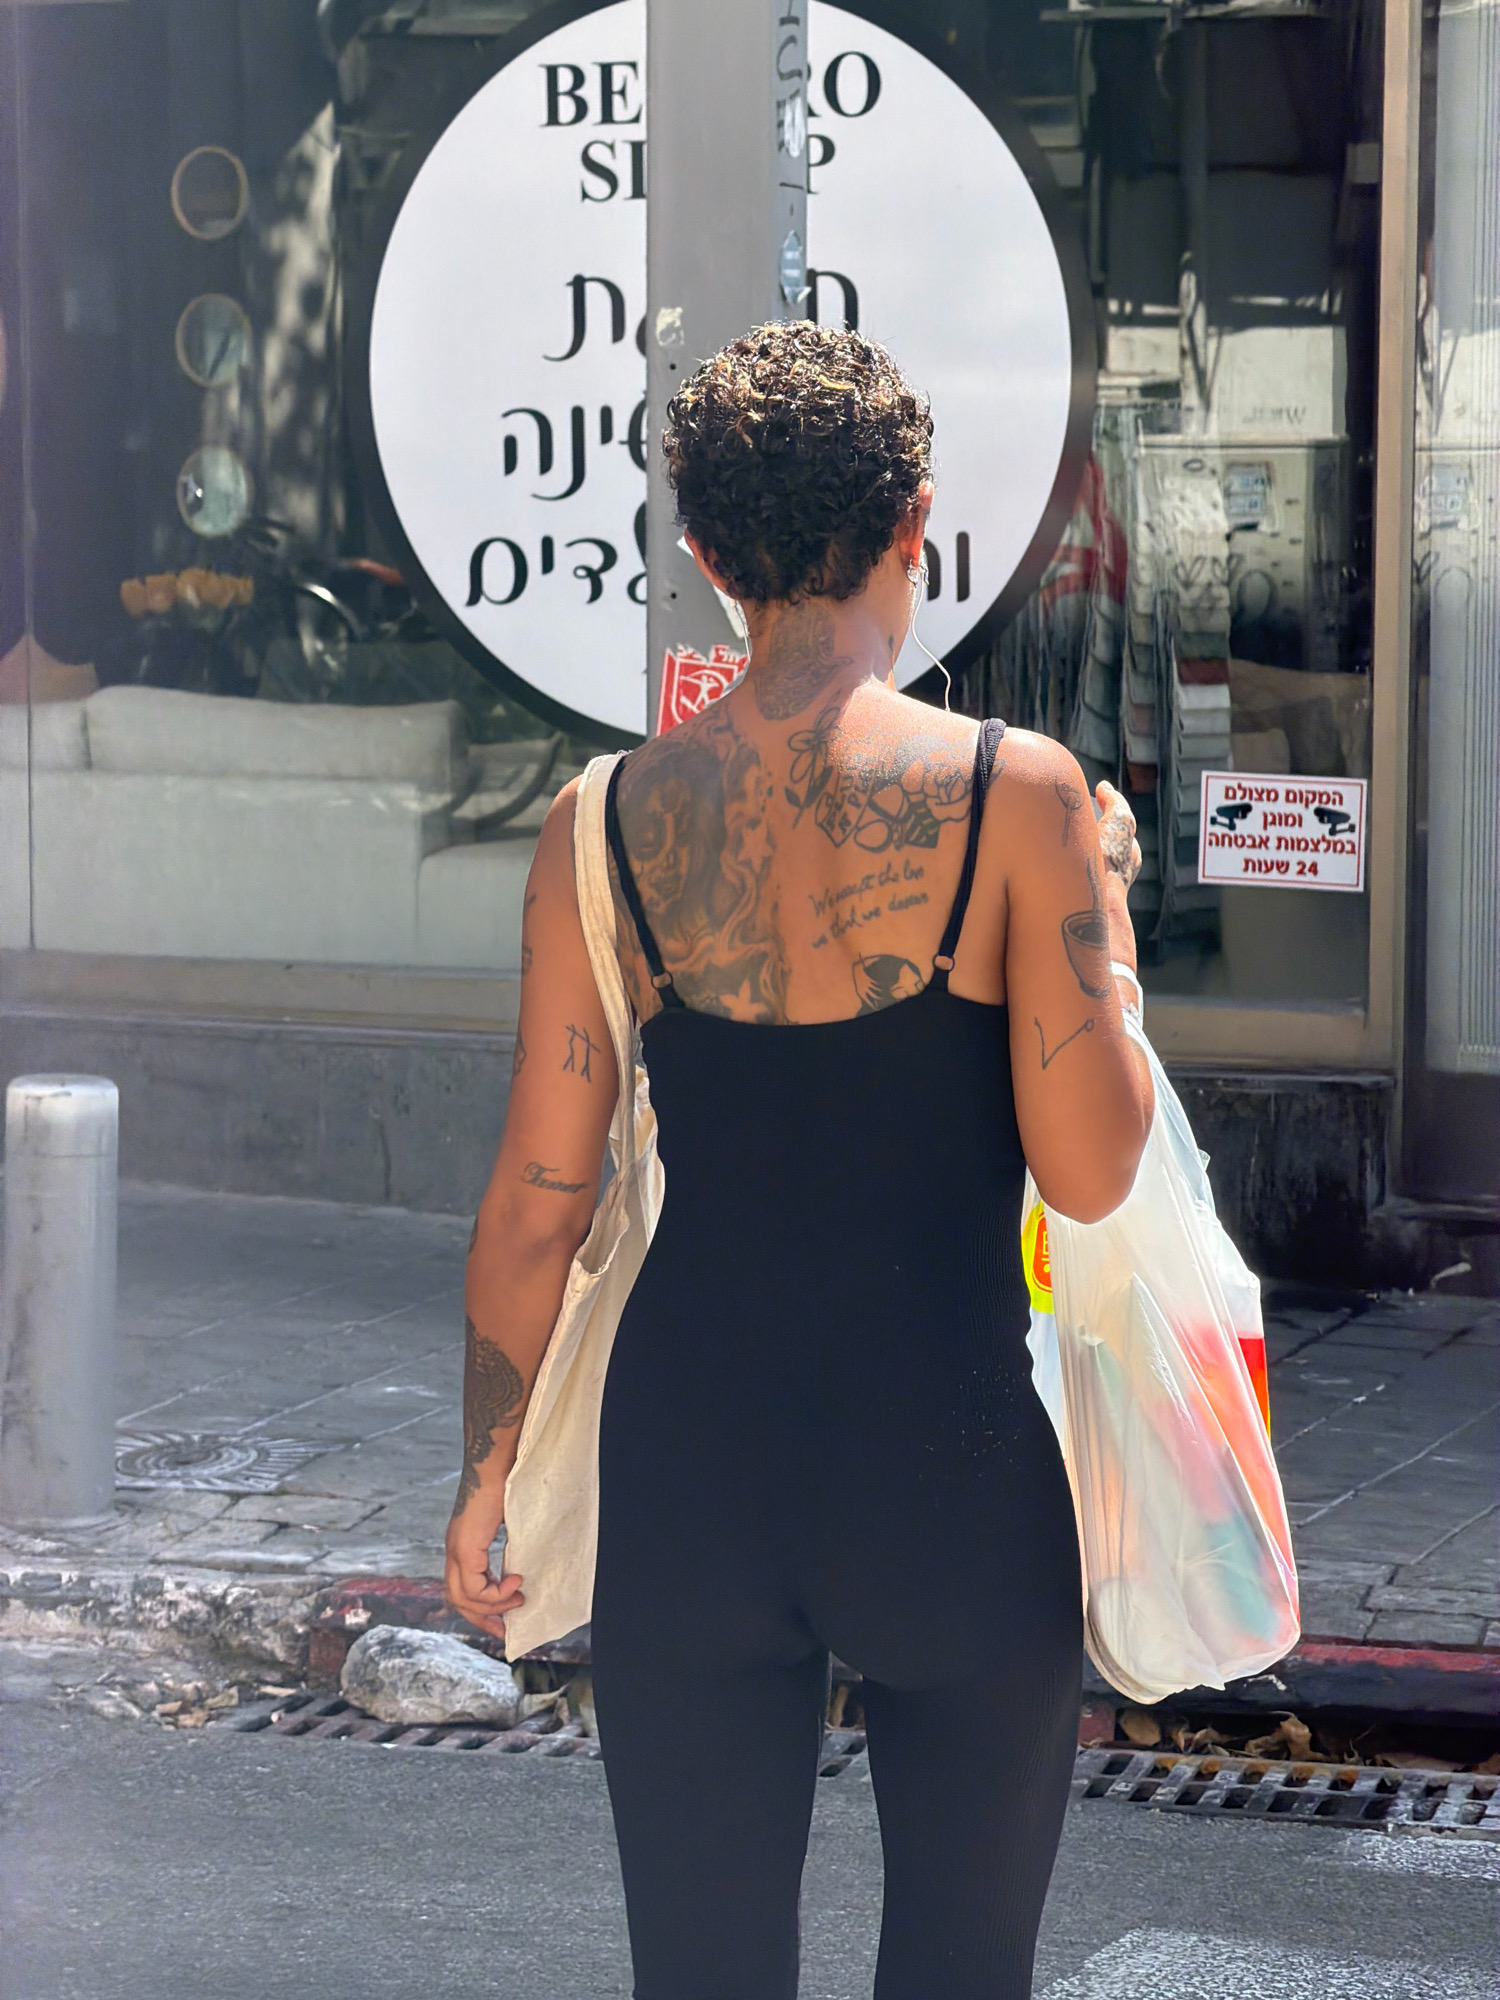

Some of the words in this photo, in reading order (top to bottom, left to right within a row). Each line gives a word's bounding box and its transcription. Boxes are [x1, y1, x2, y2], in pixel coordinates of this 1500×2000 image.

[1224, 782, 1279, 803] מצולם
[1285, 788, 1344, 809] המקום
[1262, 811, 1303, 830] ומוגן
[1208, 831, 1270, 850] אבטחה
[1243, 856, 1289, 874] שעות
[1296, 860, 1319, 876] 24
